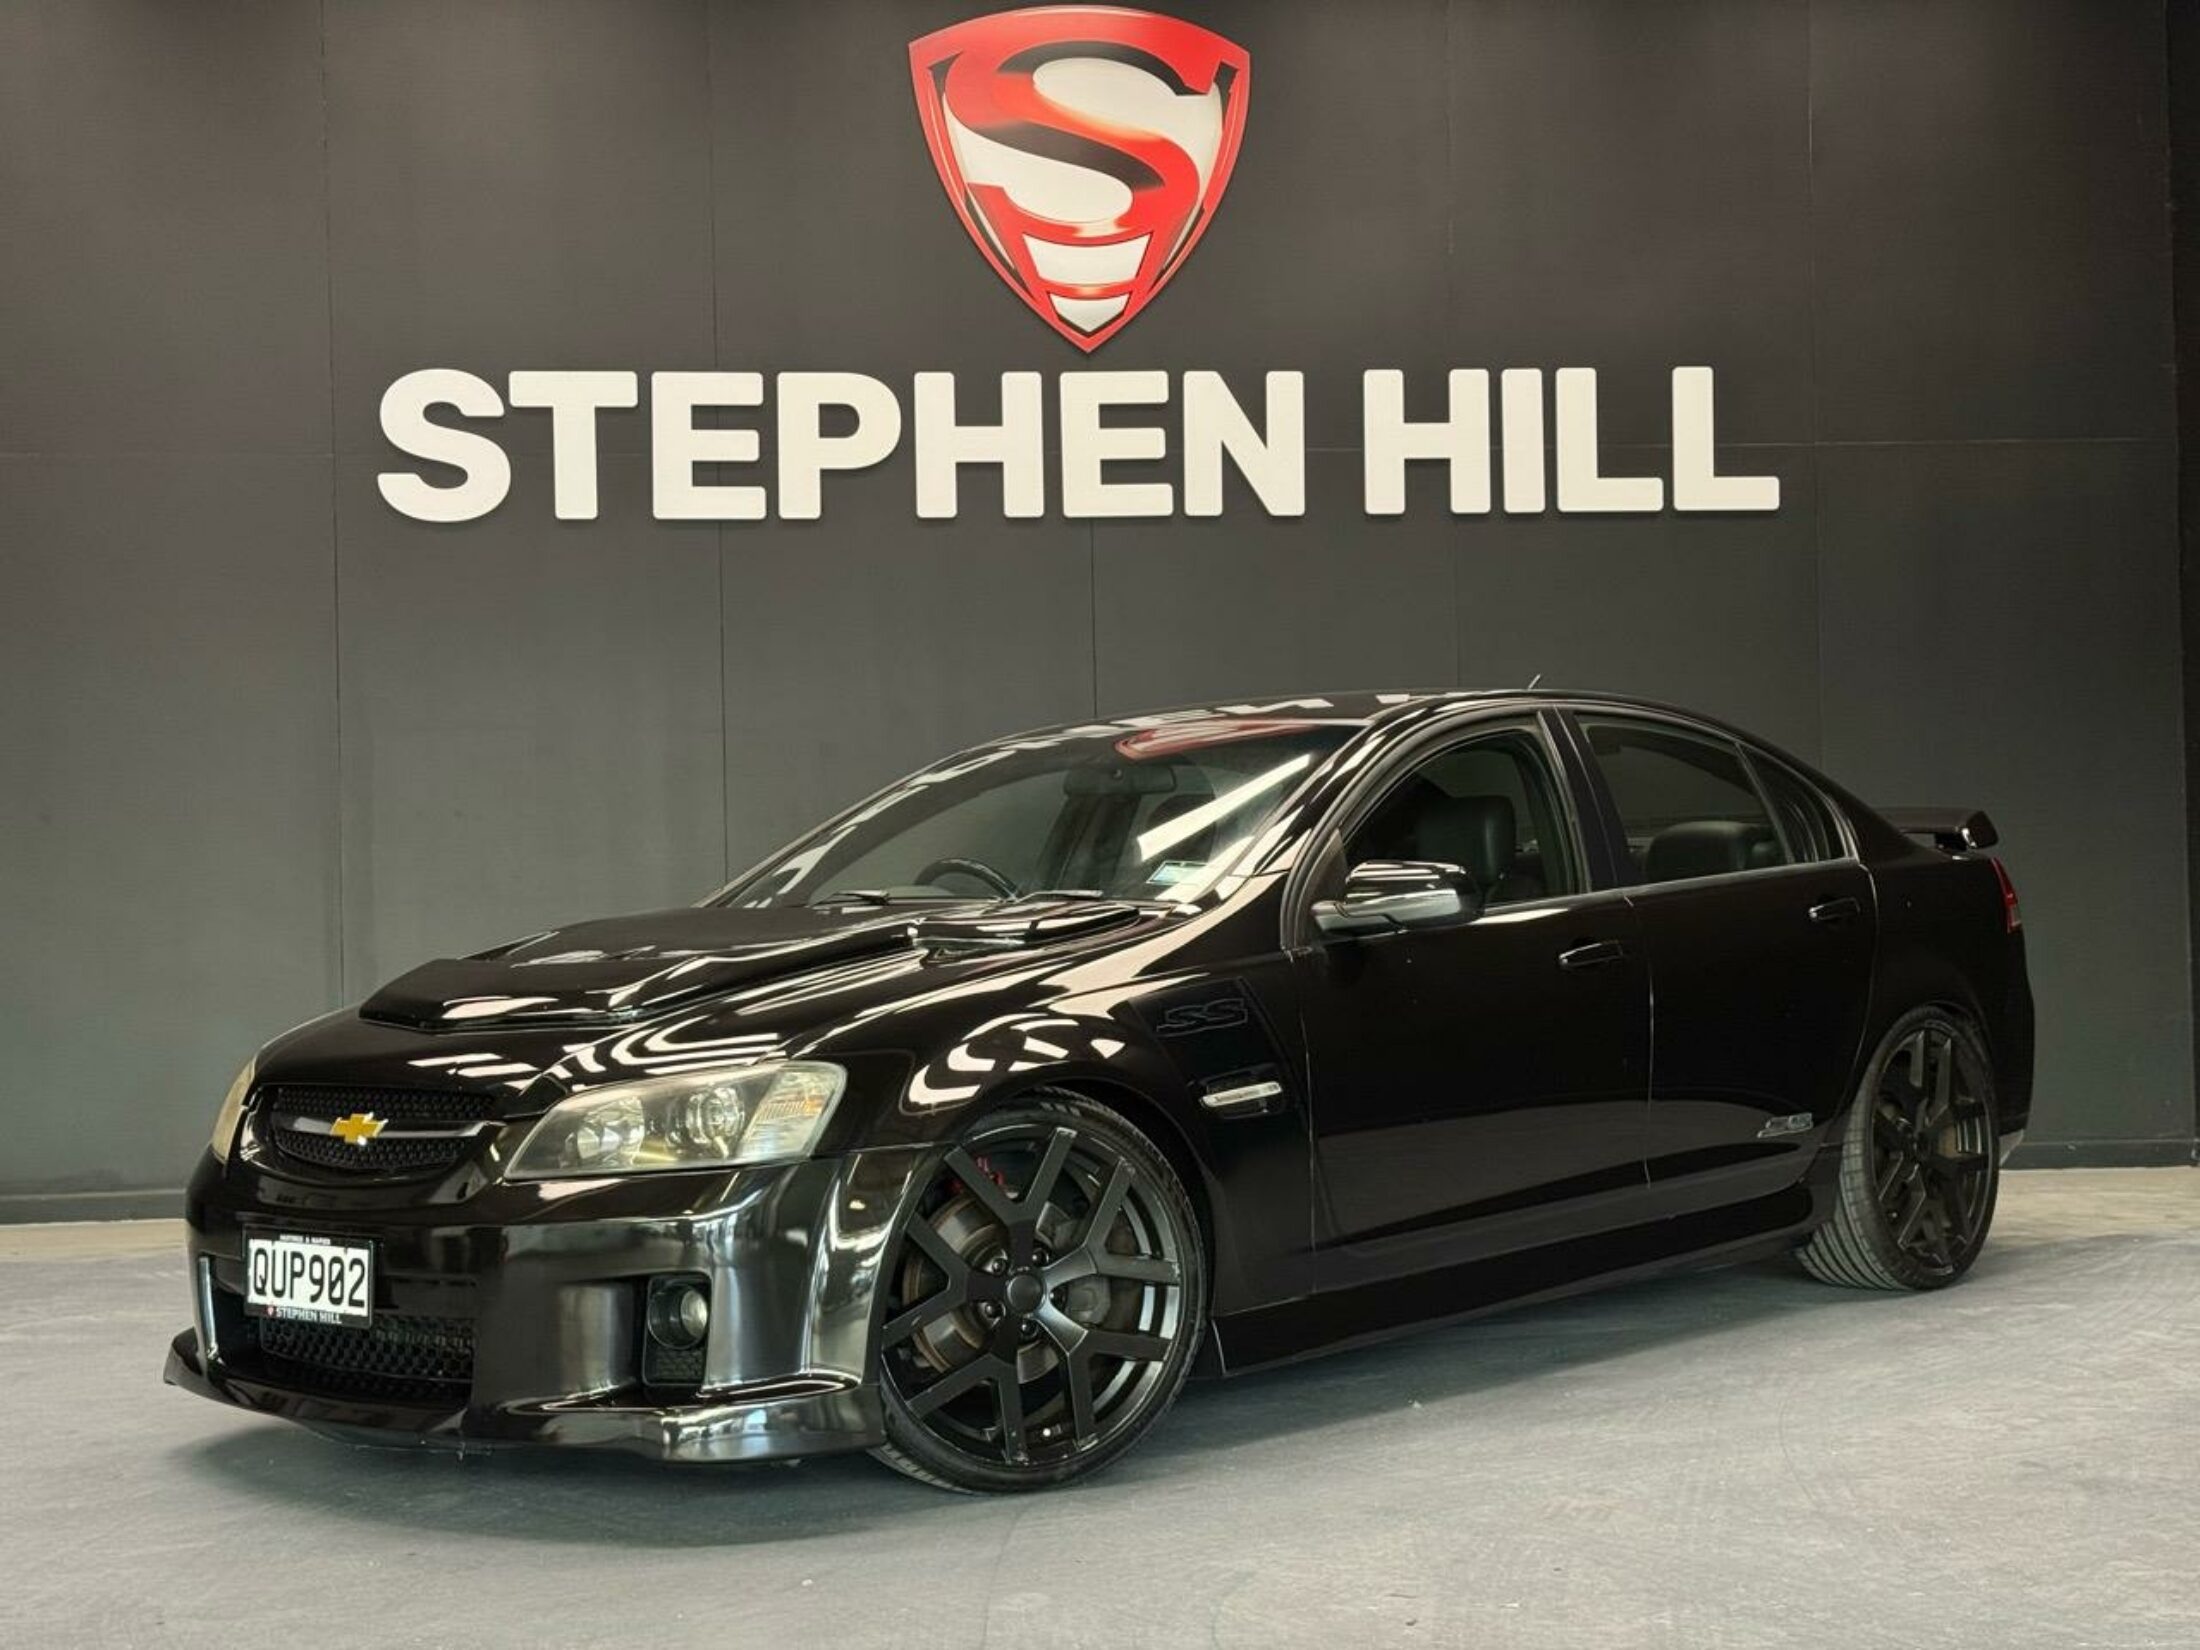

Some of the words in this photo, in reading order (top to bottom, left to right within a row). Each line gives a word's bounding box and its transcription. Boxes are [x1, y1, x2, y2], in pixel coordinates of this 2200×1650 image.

[377, 368, 1305, 523] STEPHEN
[1363, 366, 1780, 515] HILL
[253, 1247, 366, 1308] QUP902
